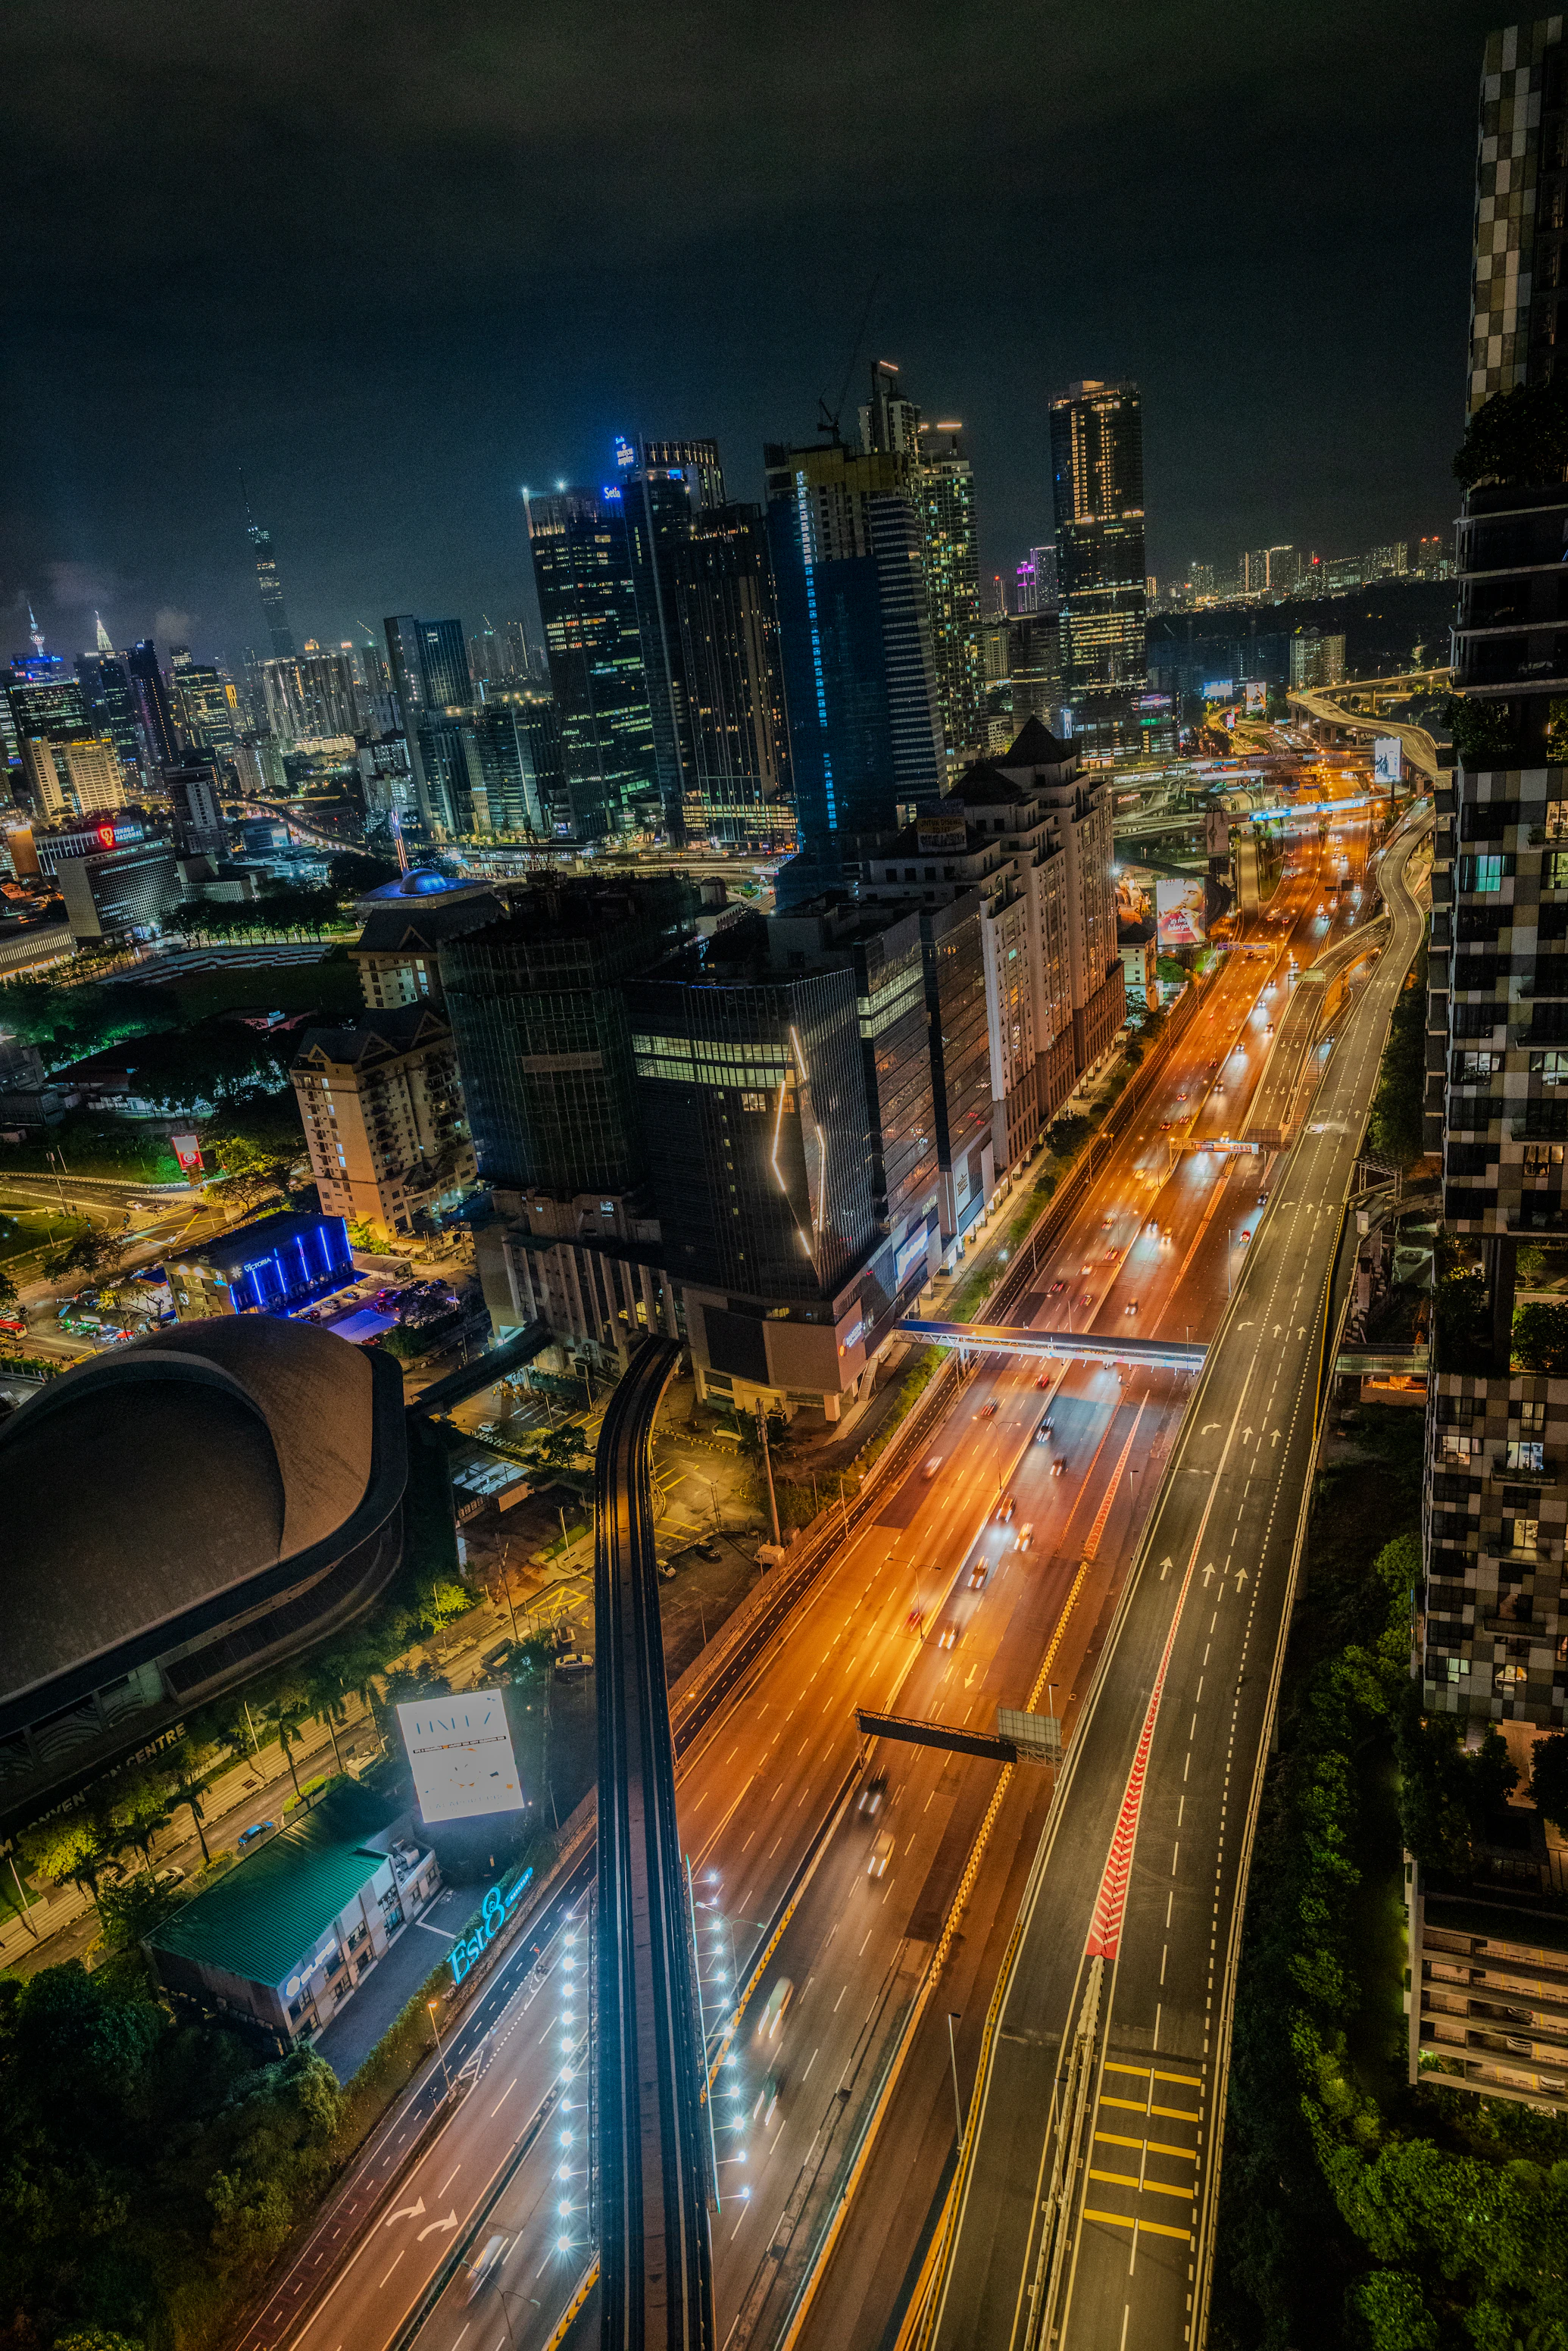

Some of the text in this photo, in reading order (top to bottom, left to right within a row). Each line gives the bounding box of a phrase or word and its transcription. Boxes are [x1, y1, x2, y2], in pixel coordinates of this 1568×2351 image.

[604, 487, 621, 499] Setia
[114, 826, 134, 835] TENAGA
[115, 830, 142, 841] NASIONAL
[244, 1258, 272, 1272] VICTORIA
[126, 1722, 187, 1767] CENTRE
